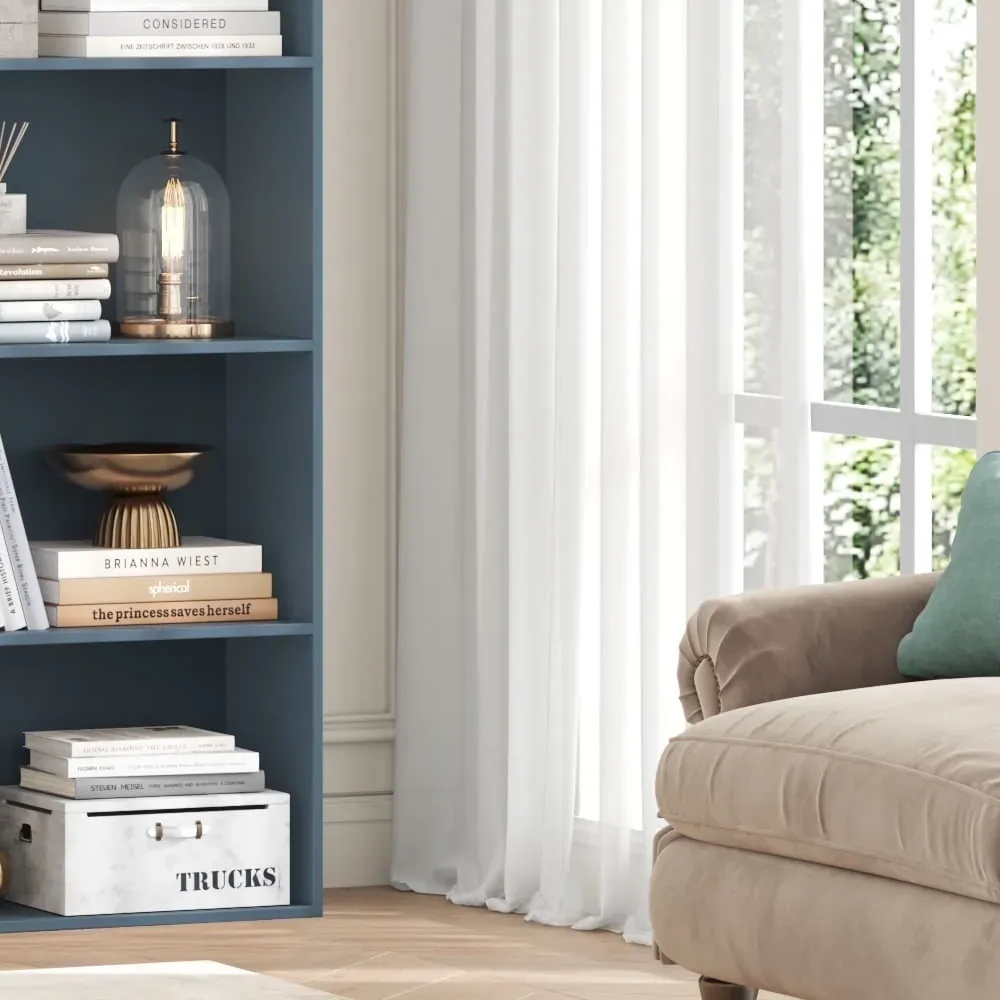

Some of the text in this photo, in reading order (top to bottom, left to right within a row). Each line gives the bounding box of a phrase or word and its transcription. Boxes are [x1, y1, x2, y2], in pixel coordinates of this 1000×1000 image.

[143, 18, 227, 29] CONSIDERED
[104, 555, 219, 569] BRIANNA WIEST
[3, 586, 14, 606] BRIEF
[148, 580, 190, 598] spherical
[92, 603, 252, 622] the princess saves herself
[90, 784, 117, 792] STEVEN
[176, 866, 277, 892] TRUCKS
